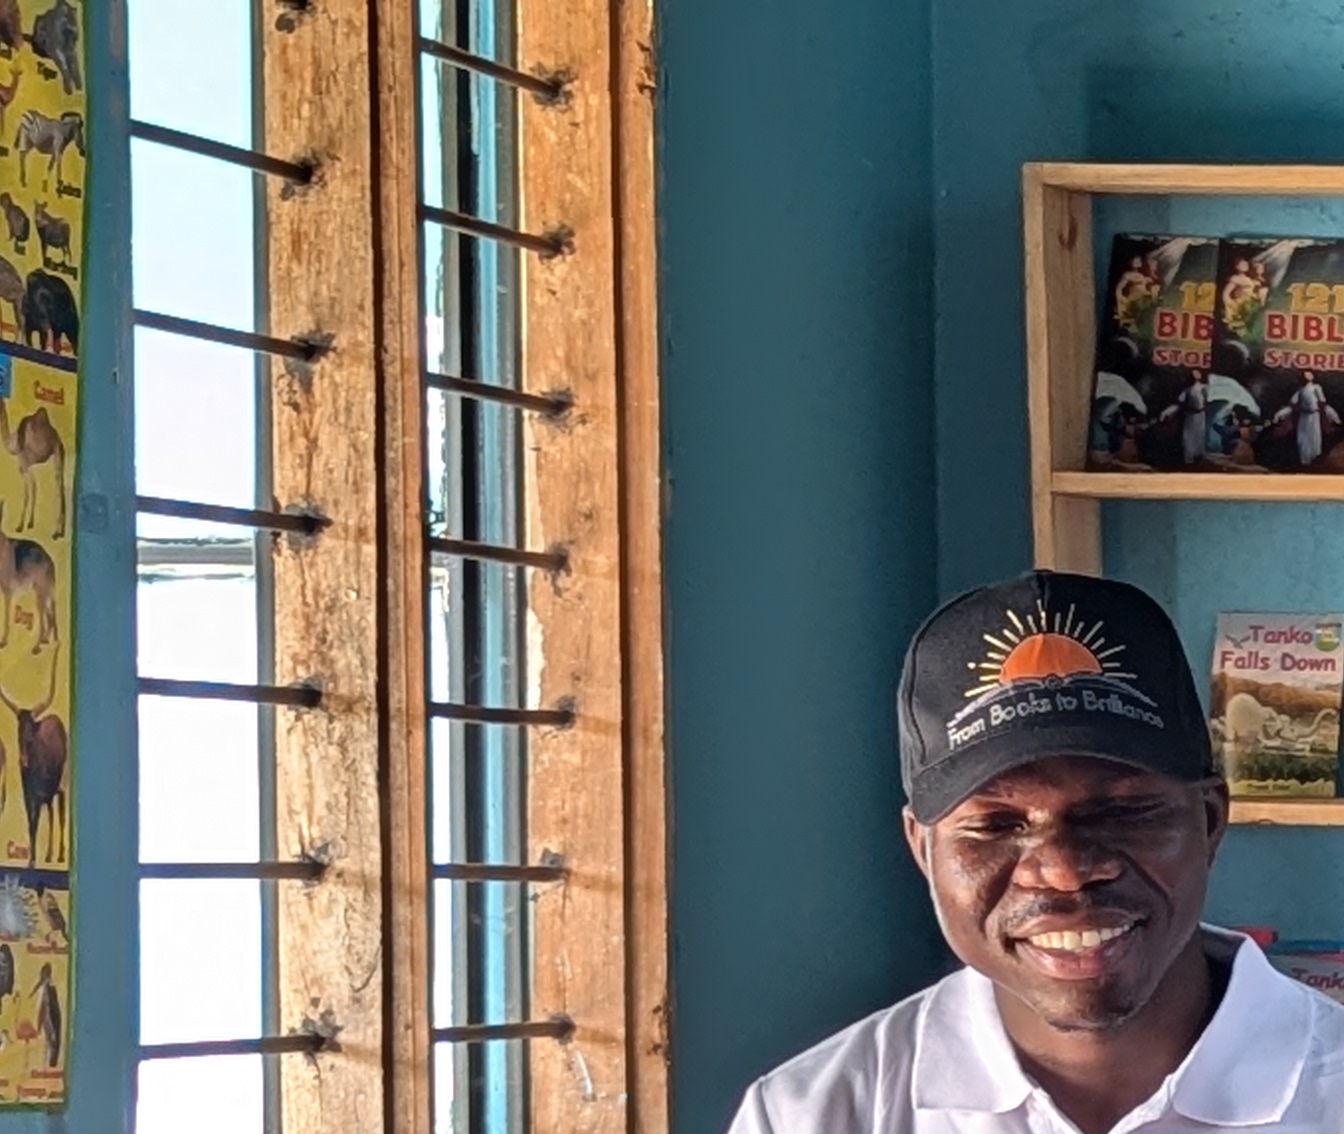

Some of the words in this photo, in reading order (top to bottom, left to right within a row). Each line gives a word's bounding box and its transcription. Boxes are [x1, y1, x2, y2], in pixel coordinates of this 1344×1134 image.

[1179, 282, 1216, 308] 12
[1154, 308, 1213, 342] BIB
[1152, 348, 1212, 368] STOR
[1249, 625, 1313, 644] Tanko
[1219, 650, 1270, 671] Falls
[1280, 653, 1336, 671] Down
[948, 716, 985, 750] From
[989, 692, 1051, 727] Books
[1055, 694, 1078, 711] to
